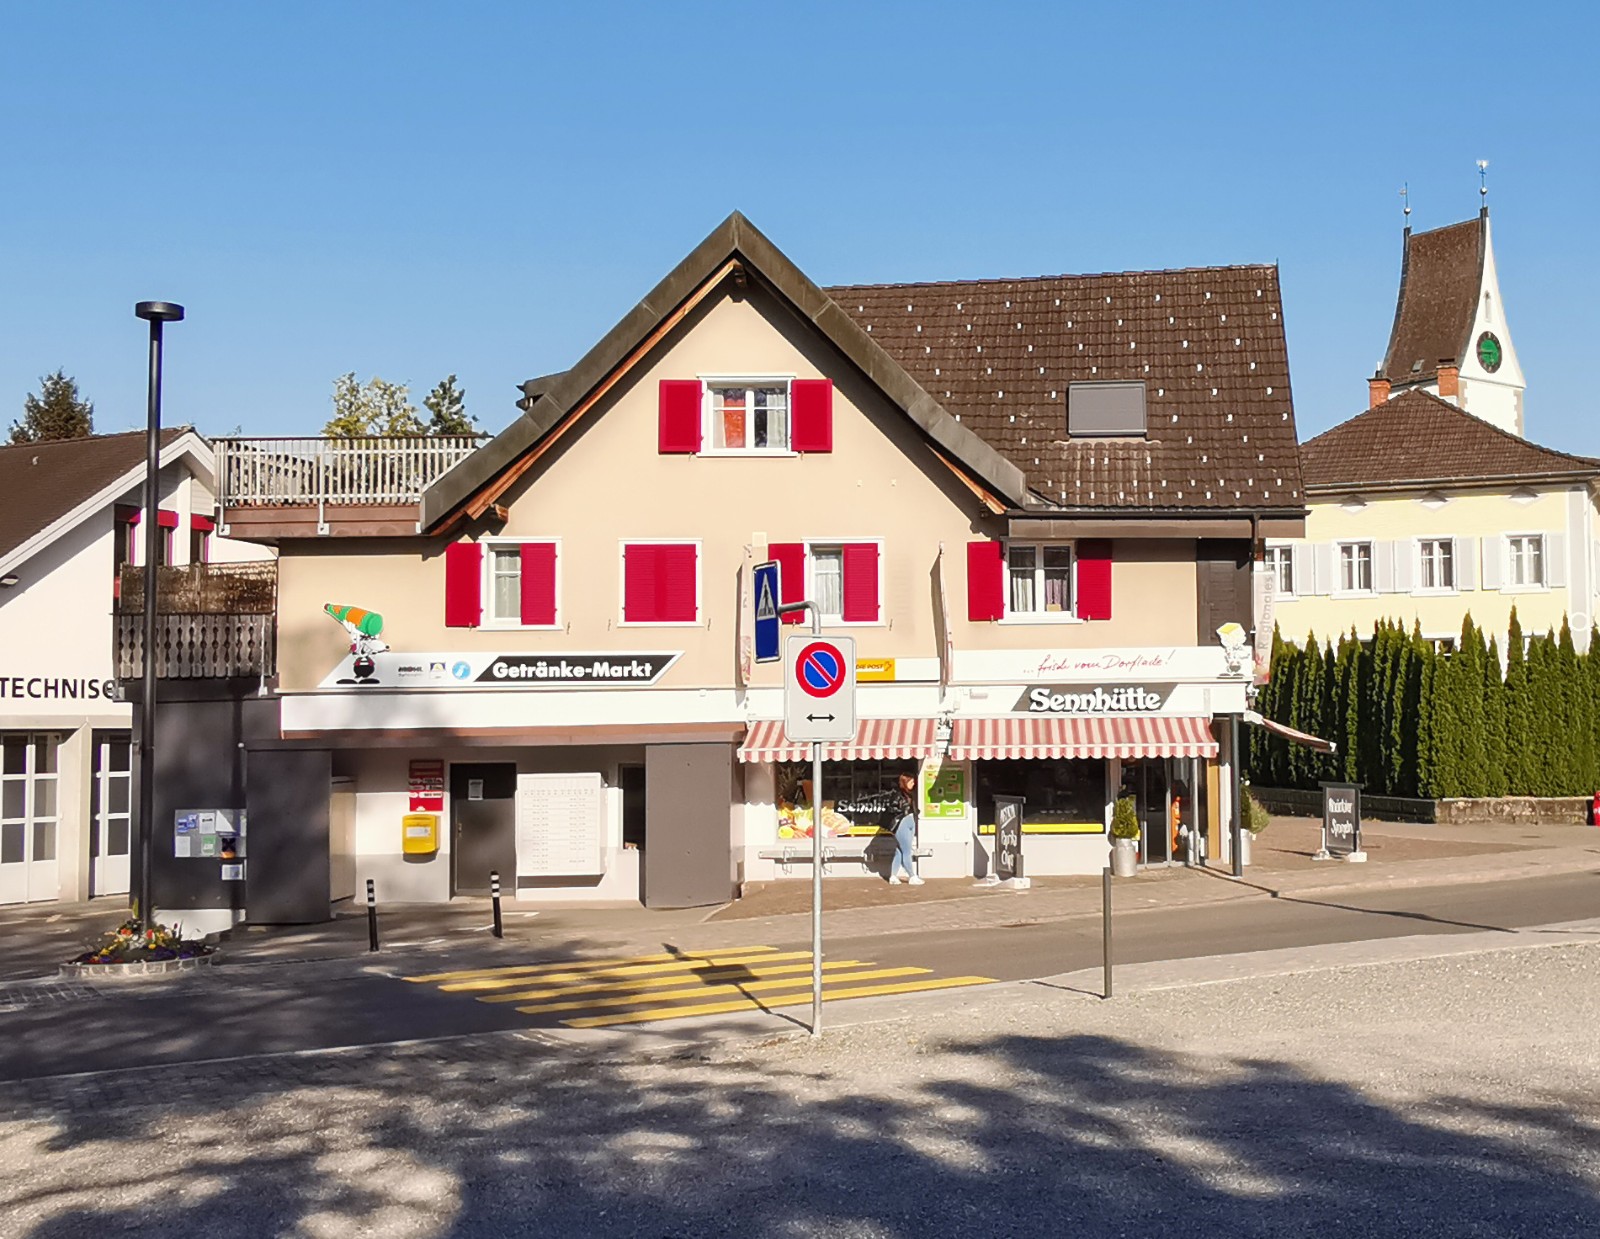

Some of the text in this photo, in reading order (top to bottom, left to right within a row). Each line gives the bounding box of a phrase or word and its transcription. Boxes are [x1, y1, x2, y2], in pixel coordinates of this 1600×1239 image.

[492, 660, 653, 678] Getränke-Markt
[0, 677, 116, 699] TECHNISC
[1029, 687, 1162, 713] Sennhütte
